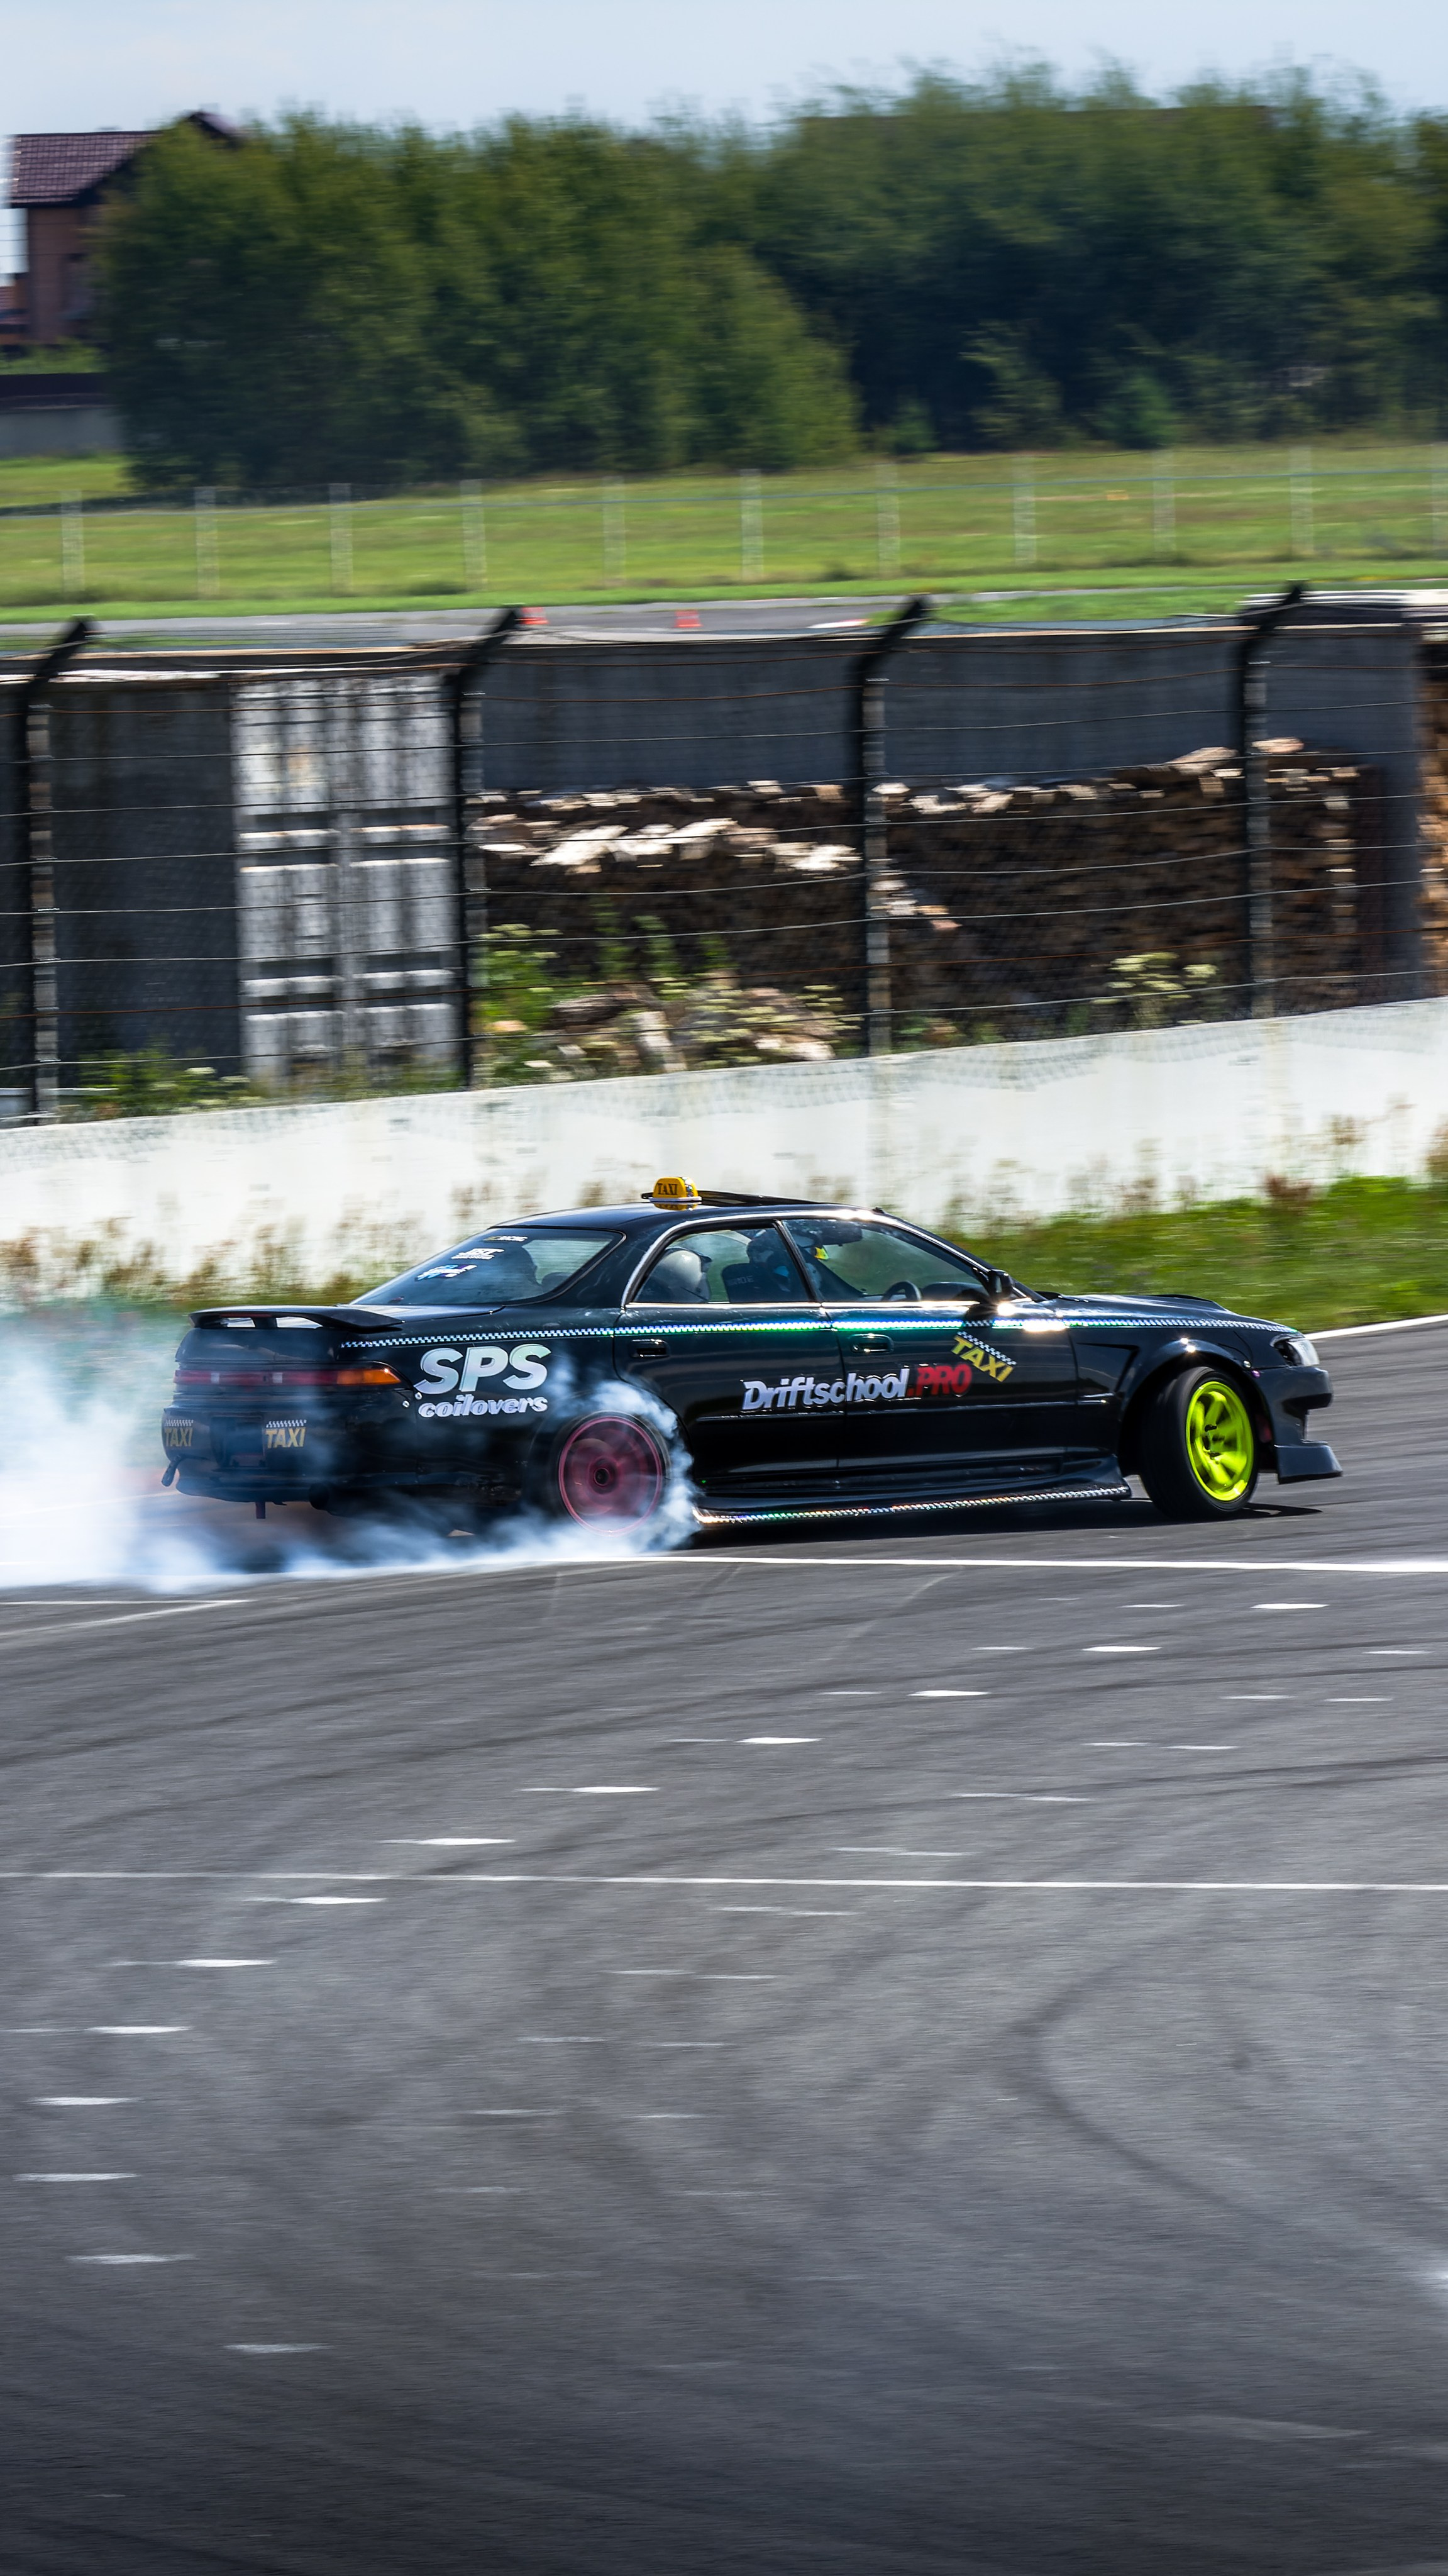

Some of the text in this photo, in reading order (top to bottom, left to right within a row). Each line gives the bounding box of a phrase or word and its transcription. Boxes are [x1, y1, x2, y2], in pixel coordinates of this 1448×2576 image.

[657, 1183, 678, 1195] TAXI
[413, 1343, 551, 1394] SPS
[951, 1335, 1014, 1382] TAXI
[742, 1363, 972, 1410] Driftschool.PRO
[418, 1394, 548, 1418] coilovers
[164, 1427, 194, 1446] TAXI
[265, 1427, 306, 1448] TAXI
